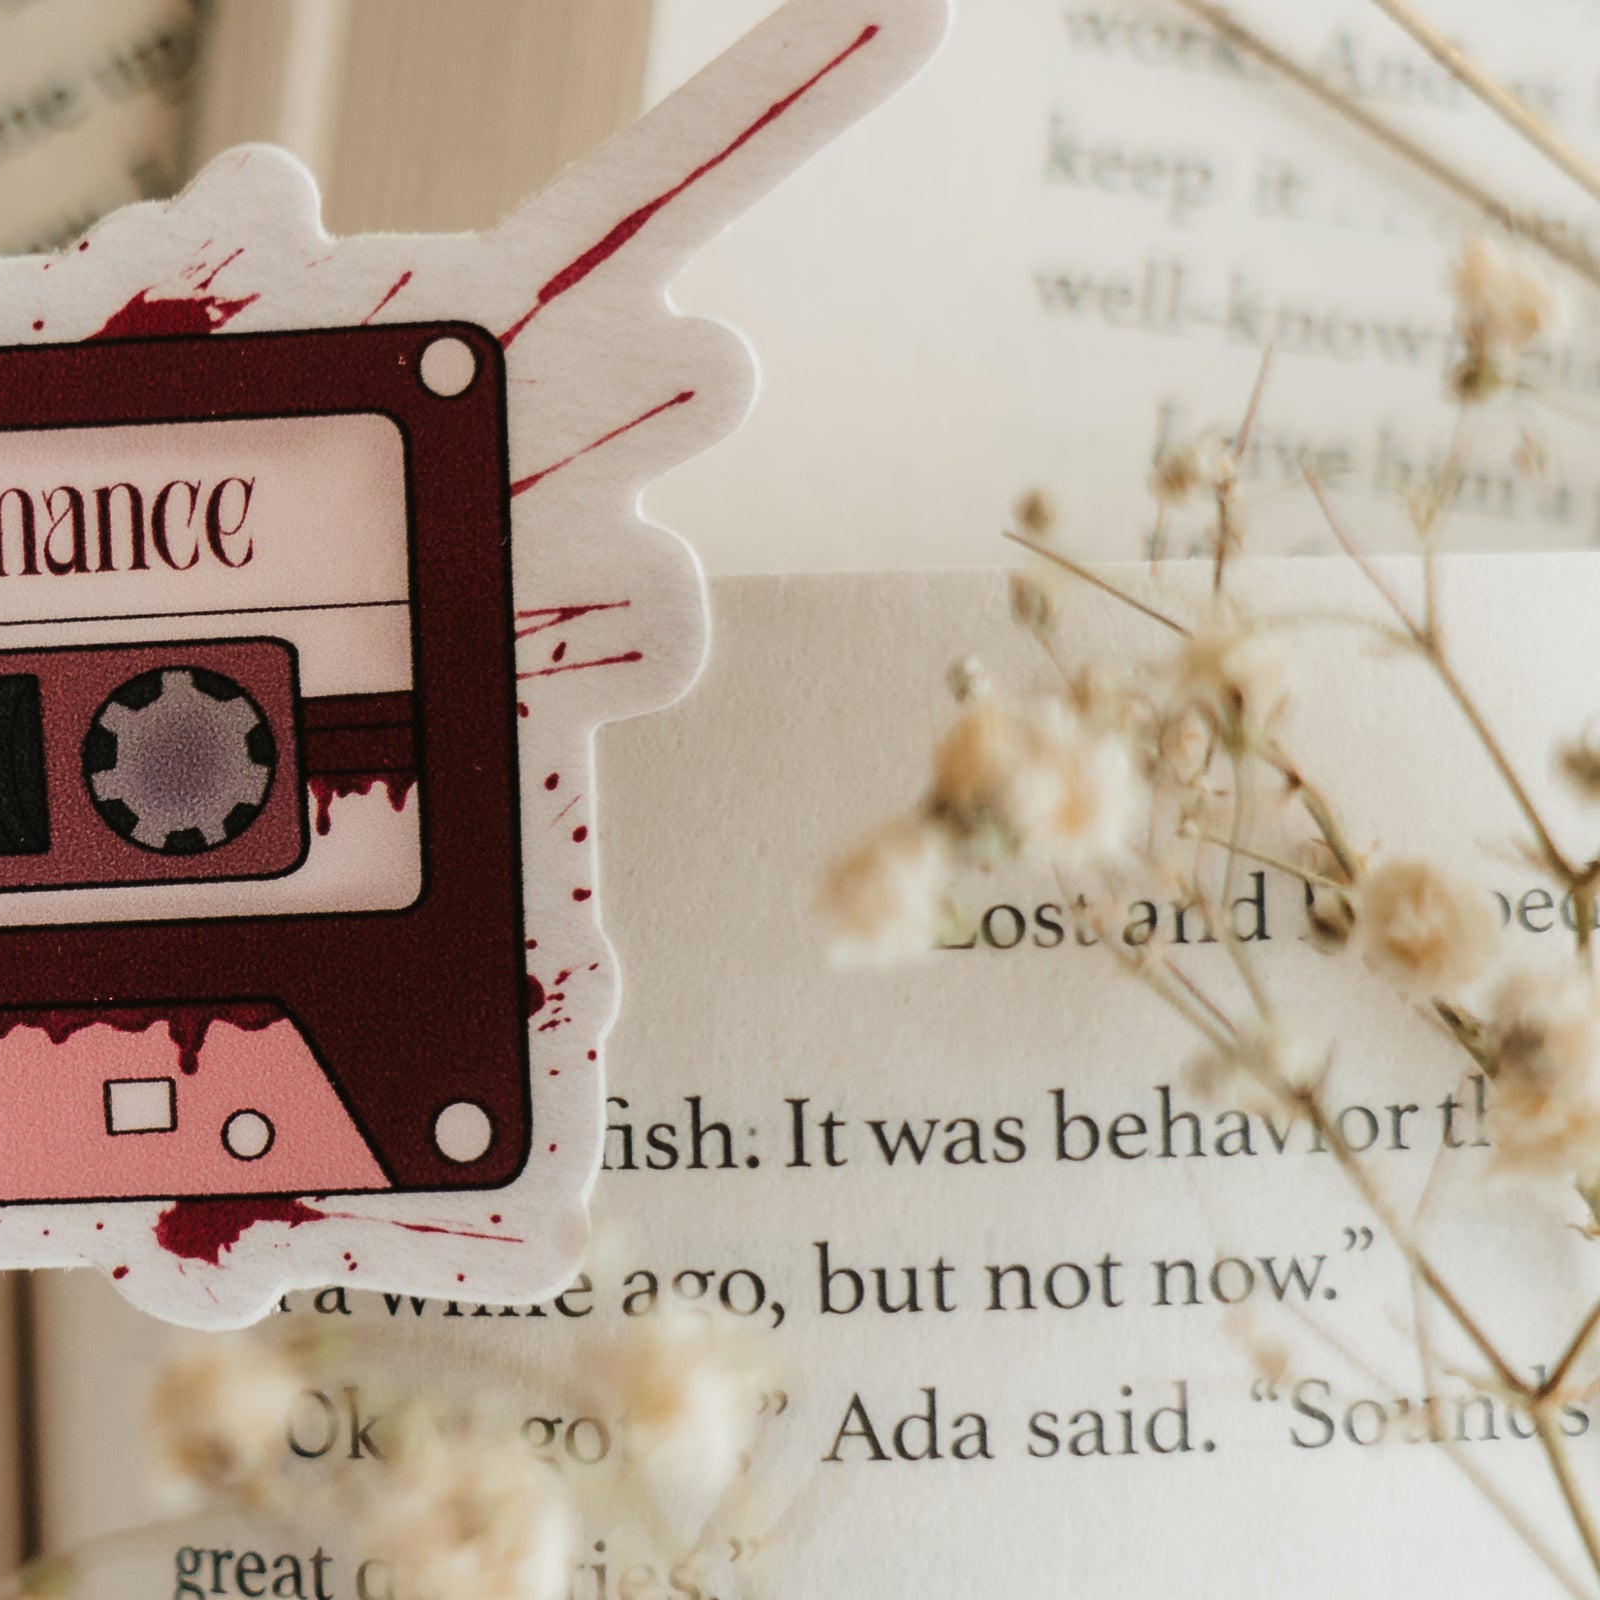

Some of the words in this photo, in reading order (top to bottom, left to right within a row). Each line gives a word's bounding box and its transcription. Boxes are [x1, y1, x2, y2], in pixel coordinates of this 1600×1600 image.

[784, 1096, 849, 1169] It
[866, 1106, 1028, 1167] was
[813, 1239, 957, 1317] but
[984, 1251, 1123, 1314] not
[1150, 1225, 1375, 1309] now.”
[821, 1385, 997, 1464] Ada
[1025, 1380, 1218, 1459] said.
